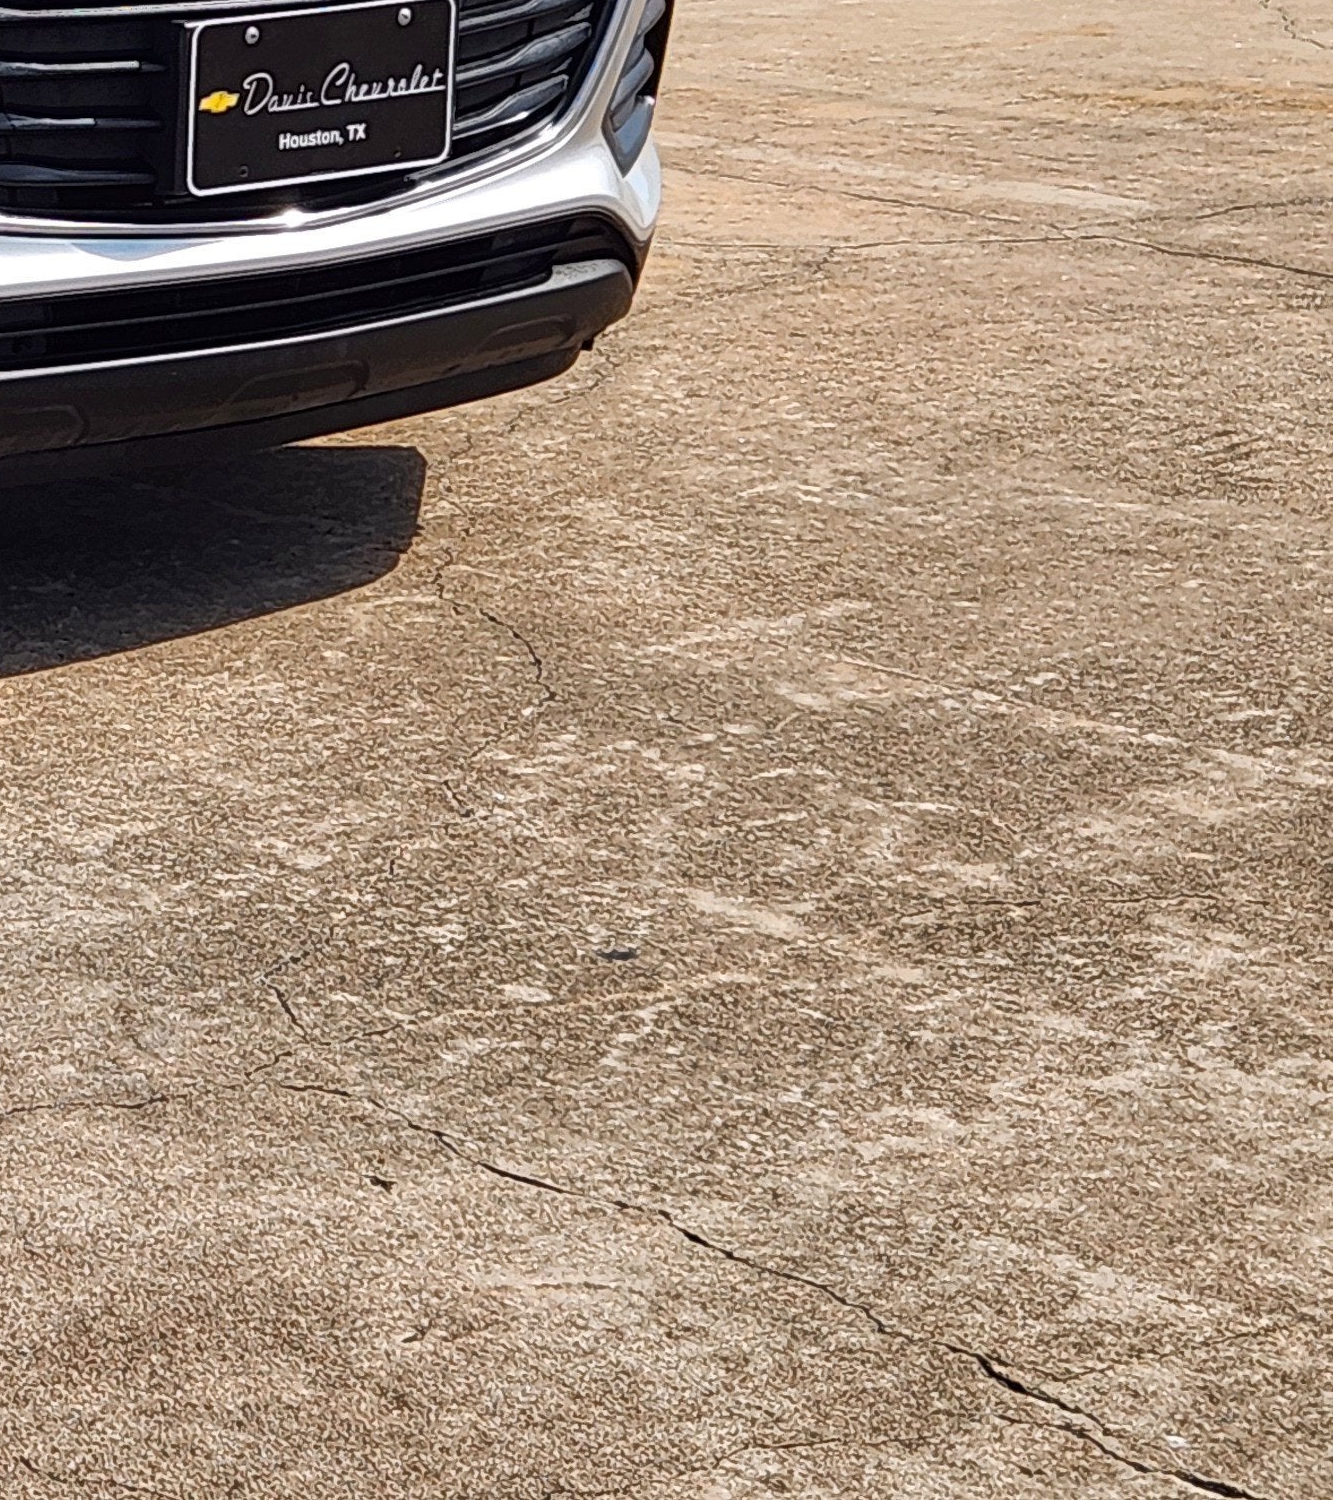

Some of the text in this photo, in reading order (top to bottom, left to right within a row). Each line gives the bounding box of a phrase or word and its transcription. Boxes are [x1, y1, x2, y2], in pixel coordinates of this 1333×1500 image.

[243, 62, 447, 116] Davis Chevrolet
[279, 122, 367, 150] Houston, TX
